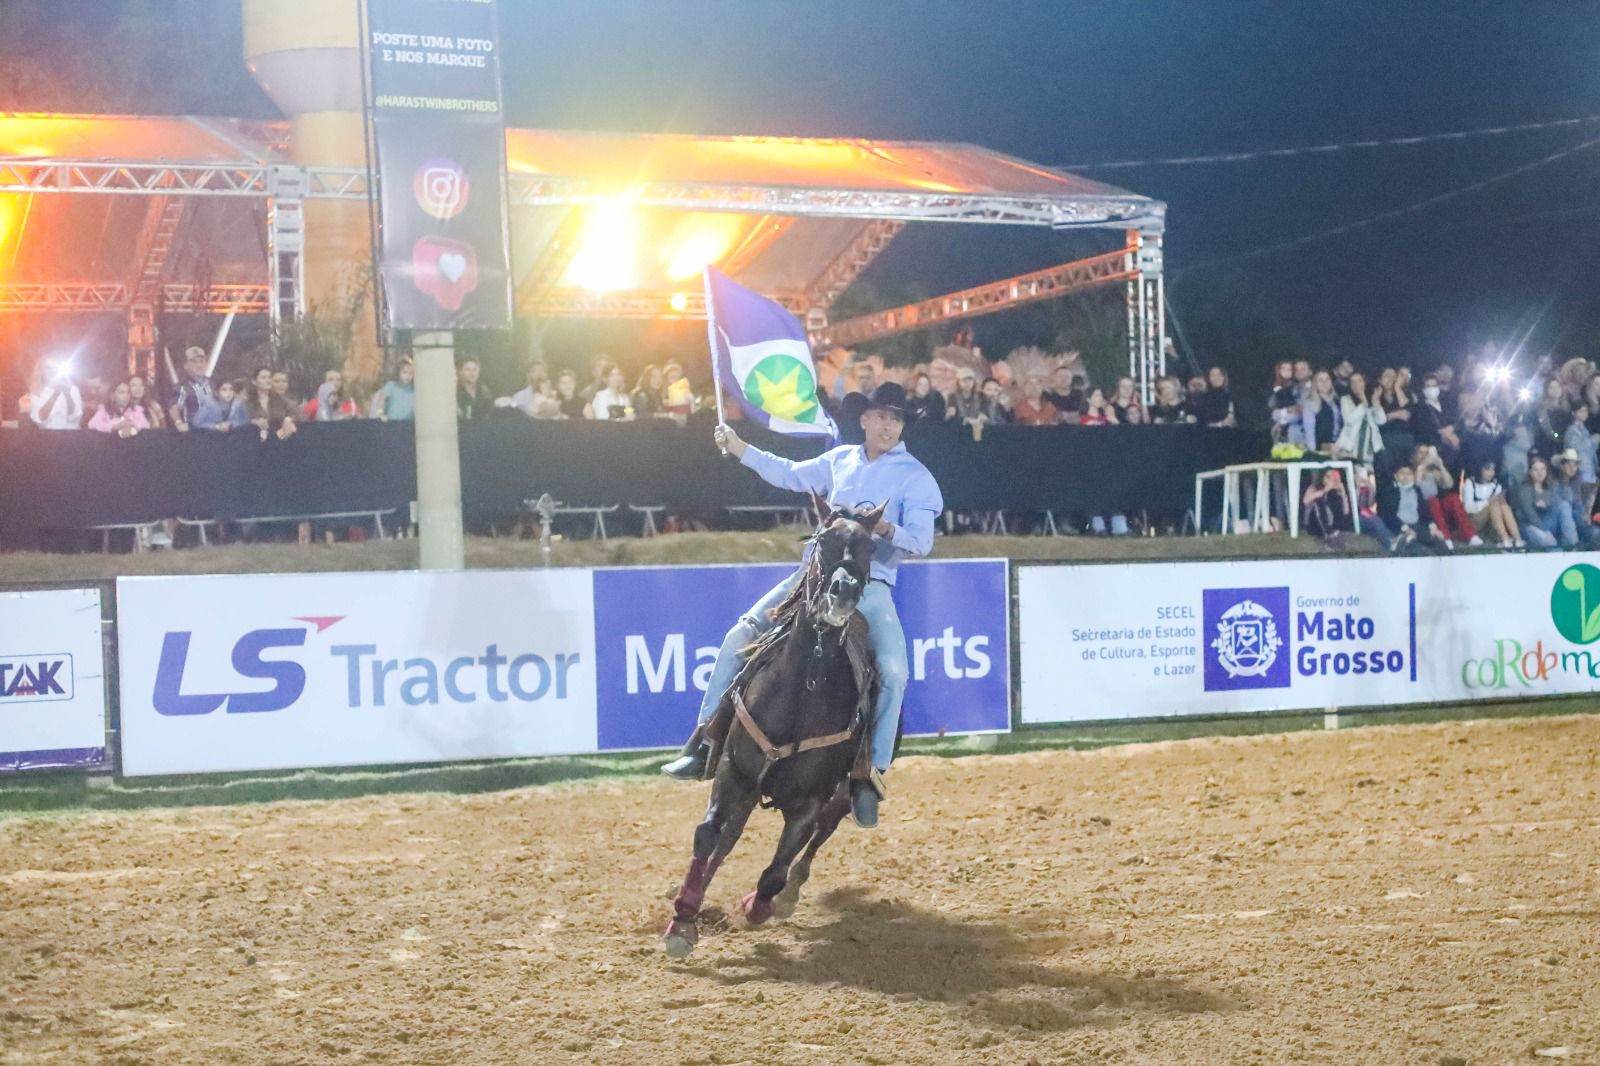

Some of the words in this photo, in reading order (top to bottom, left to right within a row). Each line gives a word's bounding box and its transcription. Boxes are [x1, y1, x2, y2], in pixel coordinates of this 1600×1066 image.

[373, 32, 418, 47] POSTE
[421, 35, 454, 49] UMA
[457, 38, 493, 52] FOTO
[383, 50, 392, 61] E
[396, 51, 424, 64] NOS
[427, 53, 486, 68] MARQUE
[376, 95, 498, 112] @HARASTWINBROTHERS
[1297, 596, 1344, 608] Governo
[1347, 595, 1360, 606] de
[1157, 606, 1196, 619] SECEL
[1072, 628, 1134, 642] Secretaria
[1138, 627, 1152, 639] de
[1155, 626, 1196, 638] Estado
[1297, 611, 1375, 642] Mato
[1082, 648, 1096, 660] de
[1100, 646, 1147, 660] Cultura,
[1151, 645, 1196, 659] Esporte
[1154, 666, 1161, 676] e
[1164, 663, 1197, 676] Lazer
[1297, 646, 1404, 677] Grosso
[152, 628, 307, 716] LS
[330, 644, 580, 708] Tractor
